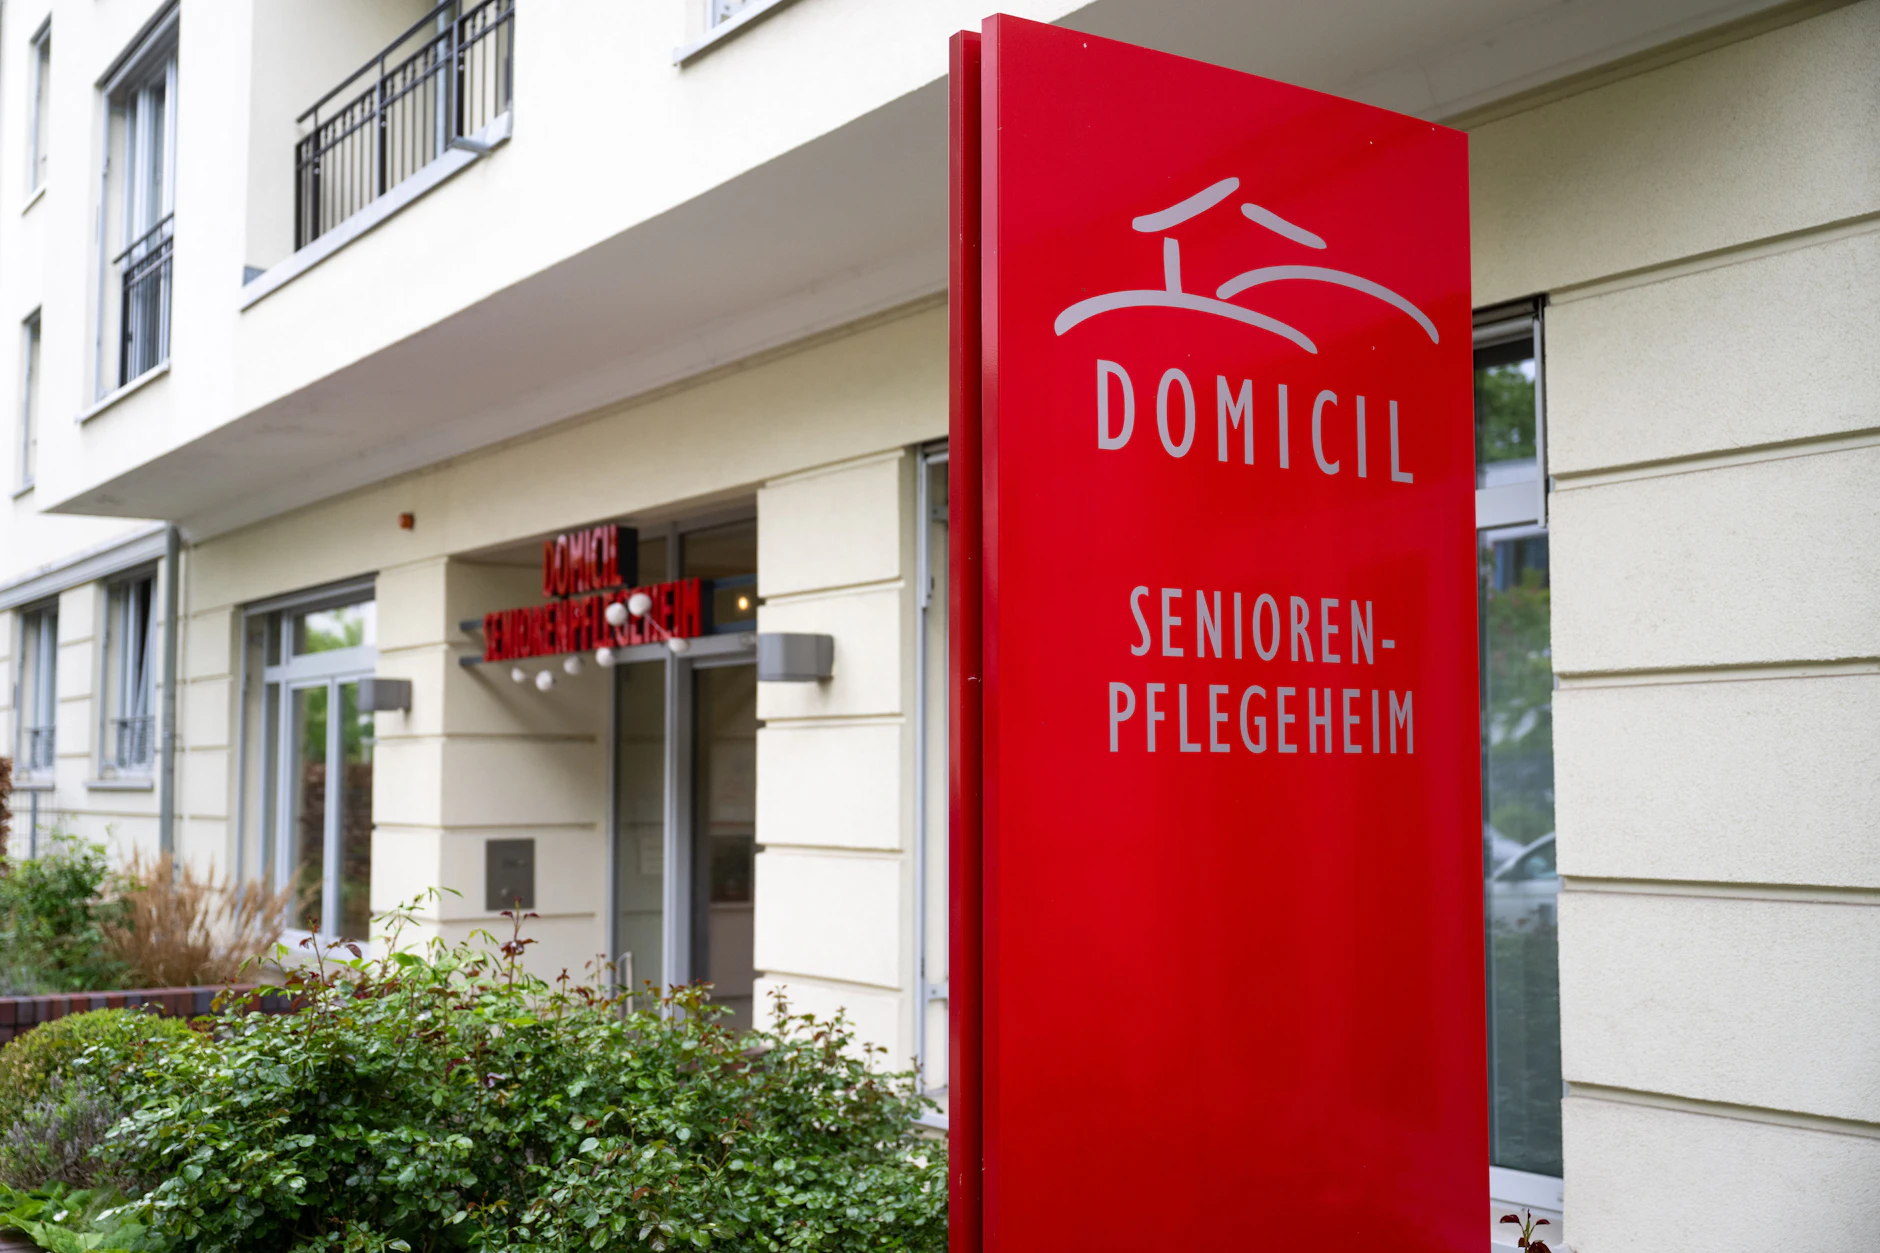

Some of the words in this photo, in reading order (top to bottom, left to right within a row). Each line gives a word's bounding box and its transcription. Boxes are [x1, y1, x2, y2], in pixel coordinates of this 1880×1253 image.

[1097, 359, 1414, 484] DOMICIL
[542, 523, 624, 598] DOMICIL
[1130, 585, 1396, 665] SENIOREN-
[1108, 681, 1414, 755] PFLEGEHEIM
